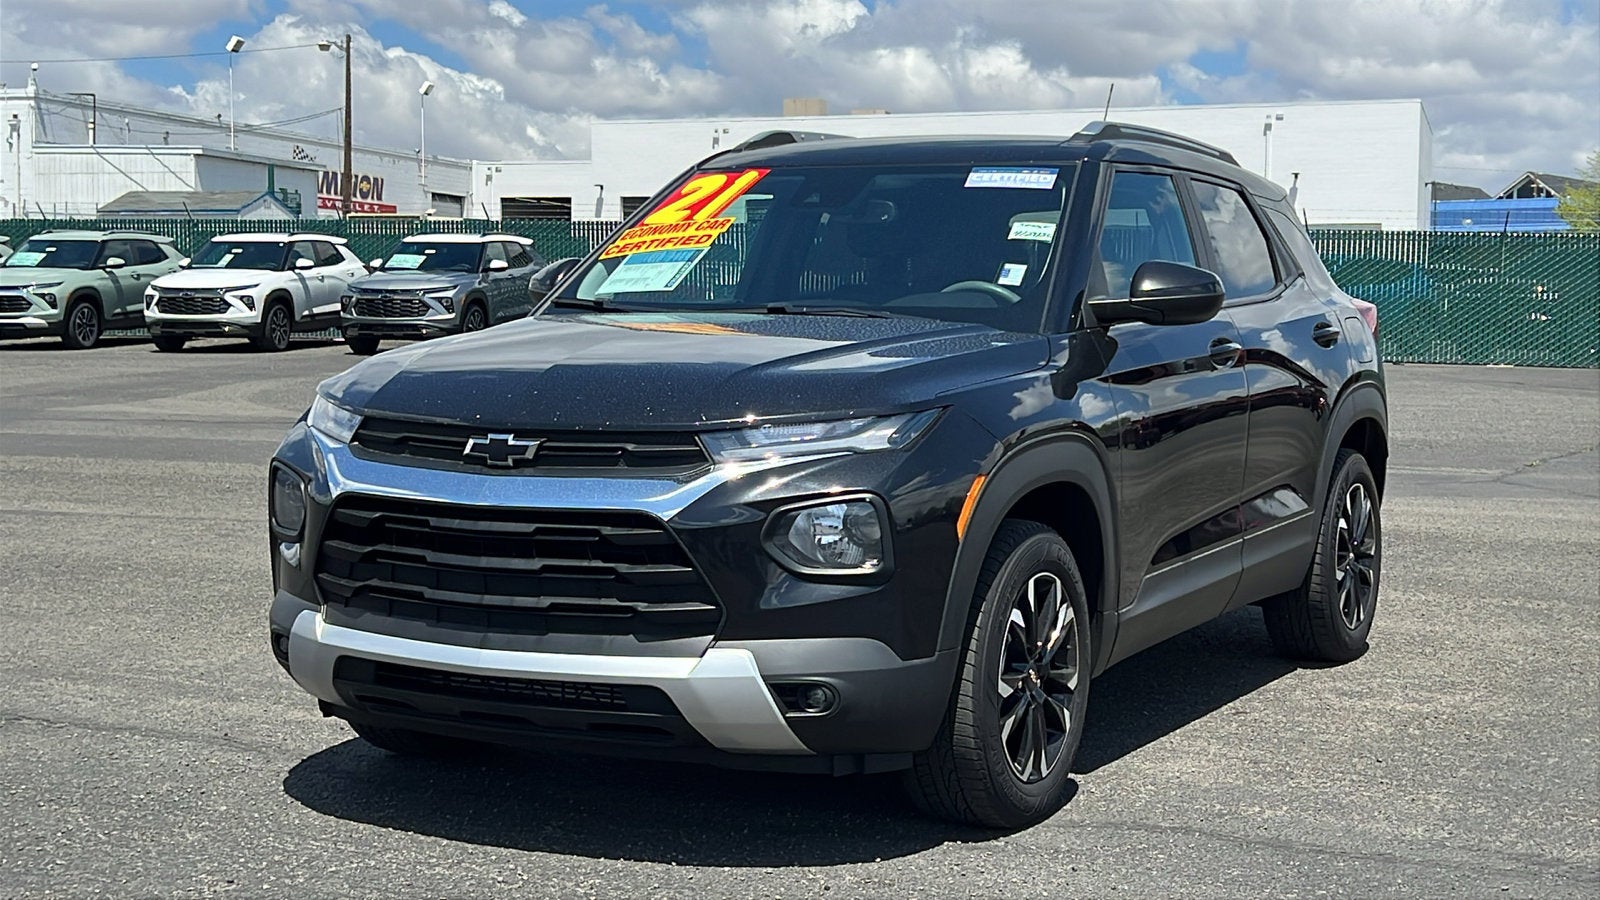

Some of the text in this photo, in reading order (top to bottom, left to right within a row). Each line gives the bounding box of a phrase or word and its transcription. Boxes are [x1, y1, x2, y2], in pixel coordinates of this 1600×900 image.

[970, 174, 1054, 184] CERTIFIED
[643, 170, 759, 224] 21
[619, 218, 731, 241] ECONOMY CAR
[604, 234, 713, 256] CERTIFIED
